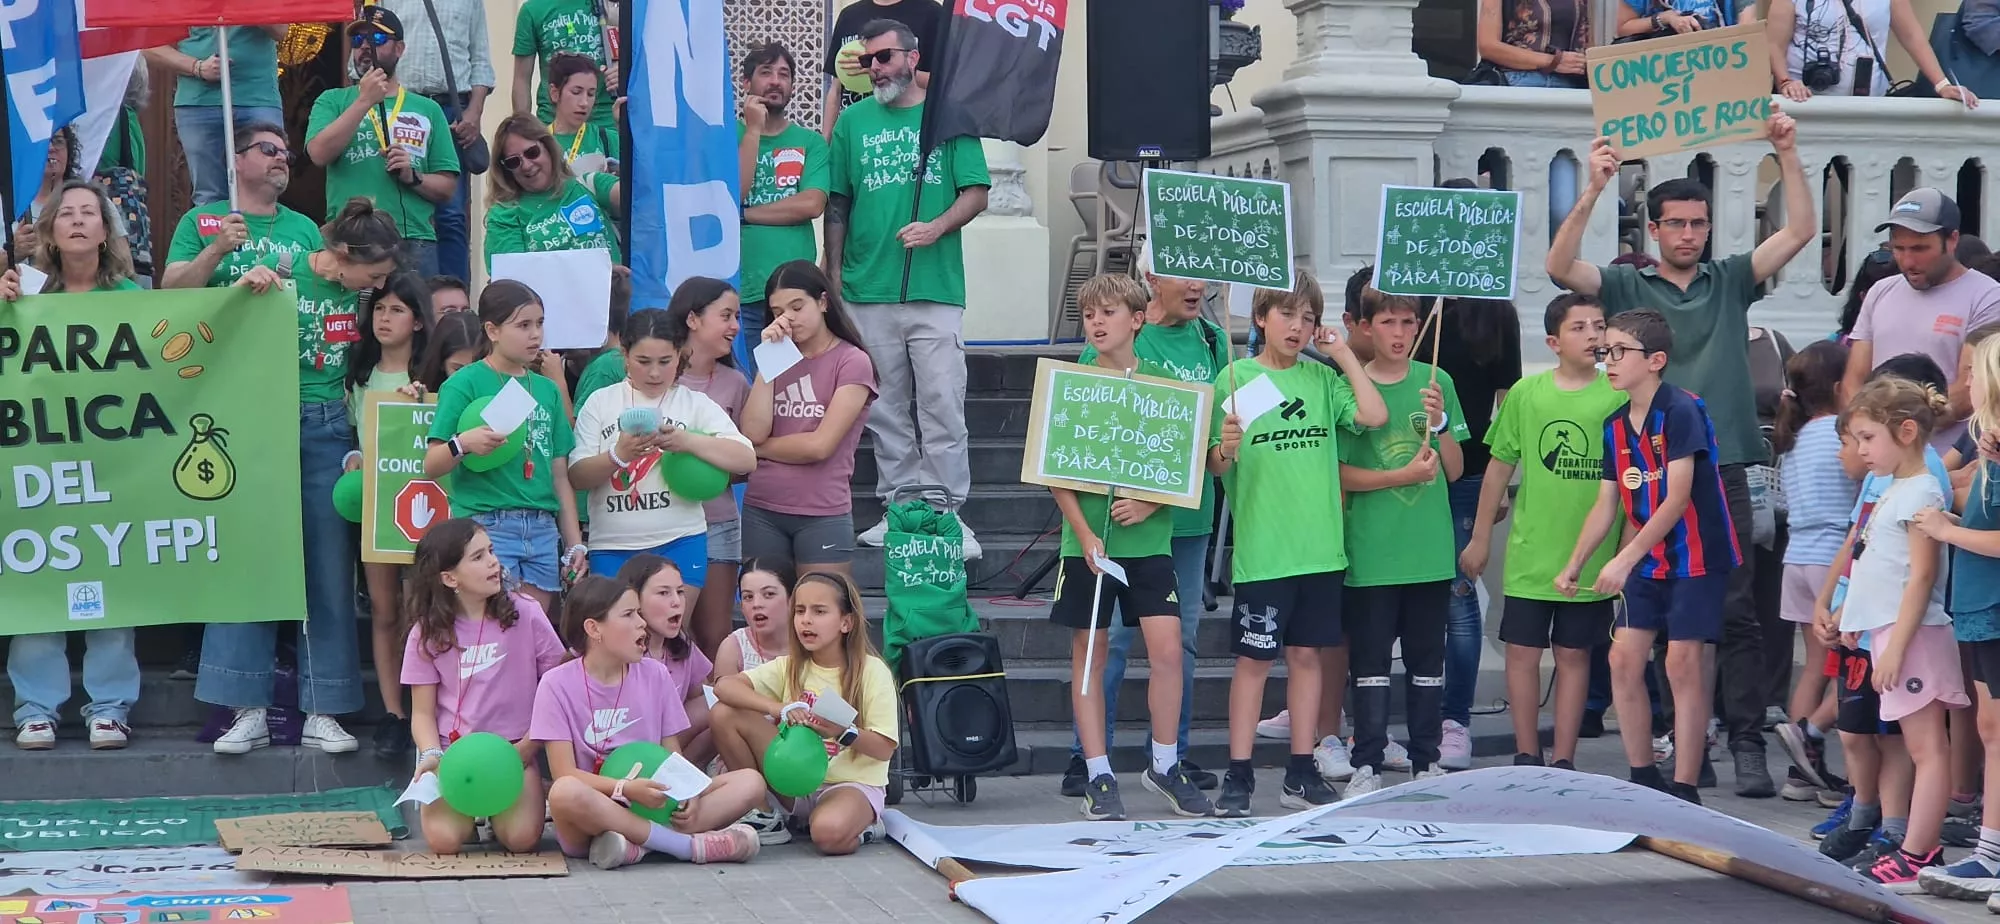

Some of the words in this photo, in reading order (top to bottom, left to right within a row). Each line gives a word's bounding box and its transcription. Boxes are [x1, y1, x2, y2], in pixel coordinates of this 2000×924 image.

[552, 38, 567, 49] DE
[1594, 42, 1748, 92] CONCIERTOS
[1657, 73, 1695, 106] SÍ
[357, 131, 373, 141] DE
[396, 128, 423, 141] STEA
[1602, 111, 1667, 147] PERO
[1674, 106, 1707, 137] DE
[863, 129, 904, 147] ESCUELA
[874, 155, 890, 168] DE
[896, 152, 936, 164] TODS
[866, 172, 900, 189] PARA
[1158, 185, 1216, 206] ESCUELA
[1223, 190, 1282, 216] PÚBLICA:
[1396, 199, 1453, 219] ESCUELA
[1459, 201, 1514, 225] PÚBLICA:
[543, 237, 560, 250] DE
[1174, 225, 1198, 239] DE
[1206, 225, 1270, 249] TOD@S
[1406, 239, 1430, 255] DE
[1438, 240, 1498, 259] TOD@S
[230, 265, 248, 276] DE
[1164, 254, 1215, 269] PARA
[1222, 258, 1283, 281] TOD@S
[1391, 271, 1440, 286] PARA
[1445, 271, 1506, 291] TOD@S
[326, 321, 346, 331] UGT
[0, 322, 152, 375] PARA
[1063, 386, 1127, 408] ESCUELA
[1133, 392, 1193, 422] PÚBLICA:
[601, 424, 616, 440] THE
[1074, 425, 1099, 439] DE
[1109, 426, 1174, 453] TOD@S
[1275, 440, 1320, 451] SPORTS
[1057, 455, 1111, 471] PARA
[1118, 459, 1183, 485] TOD@S
[13, 460, 112, 508] DEL
[90, 522, 133, 567] Y
[144, 516, 219, 564] FP!
[888, 540, 939, 559] ESCUELA
[1240, 637, 1277, 649] ARMOUR
[1244, 631, 1273, 642] UNDER
[461, 643, 498, 664] NIKE
[593, 708, 629, 729] NIKE
